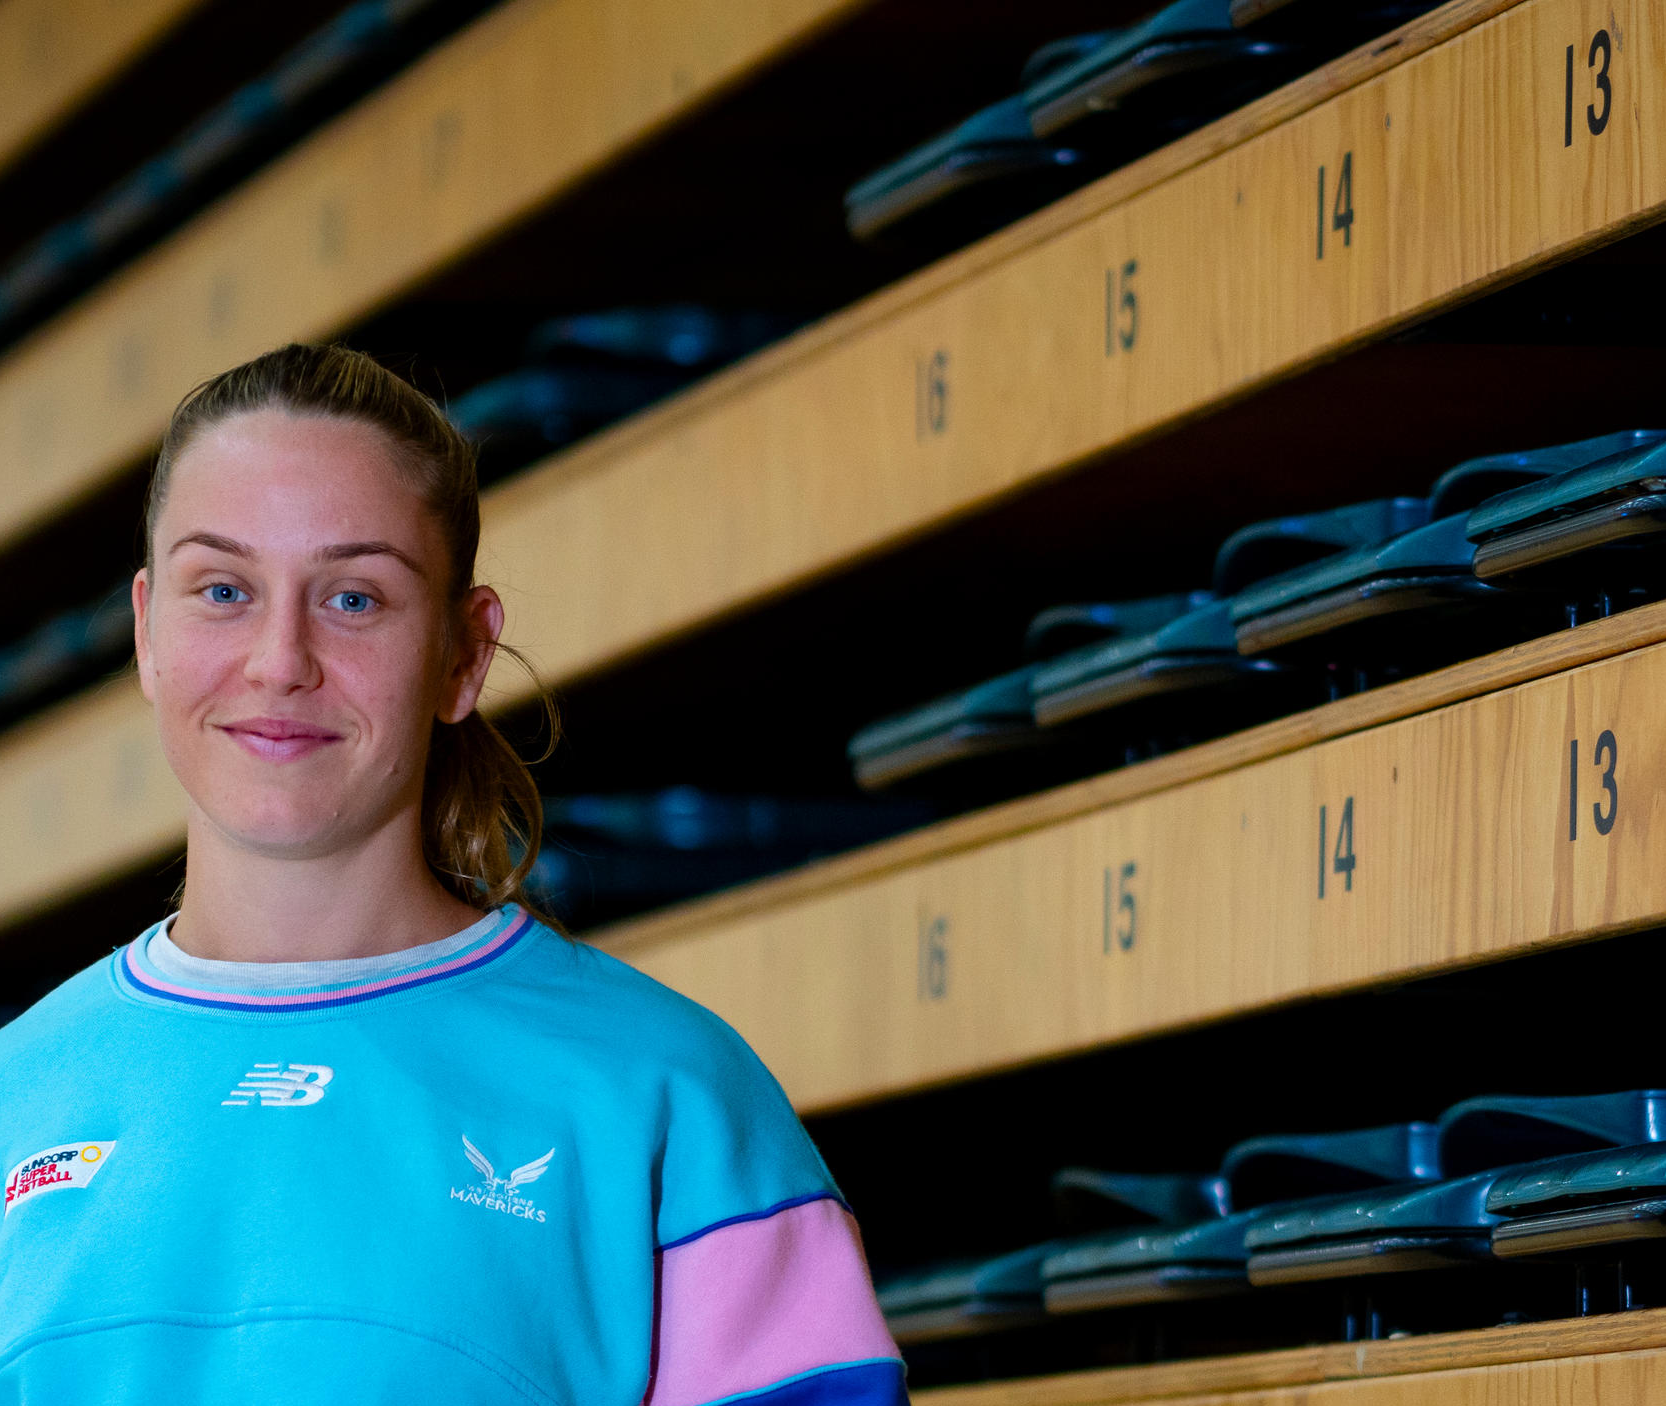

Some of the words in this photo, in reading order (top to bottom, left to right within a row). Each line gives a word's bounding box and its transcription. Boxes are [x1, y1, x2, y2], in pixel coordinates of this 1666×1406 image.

[1565, 30, 1612, 146] 13
[1318, 152, 1354, 259] 14
[1108, 260, 1138, 351] 15
[917, 351, 950, 435] 16
[1569, 730, 1618, 841] 13
[1319, 797, 1356, 898] 14
[1105, 862, 1136, 951] 15
[920, 917, 948, 999] 16
[18, 1163, 58, 1186] SUPER
[21, 1150, 79, 1176] SUNCORP
[450, 1186, 547, 1223] MAVERICKS
